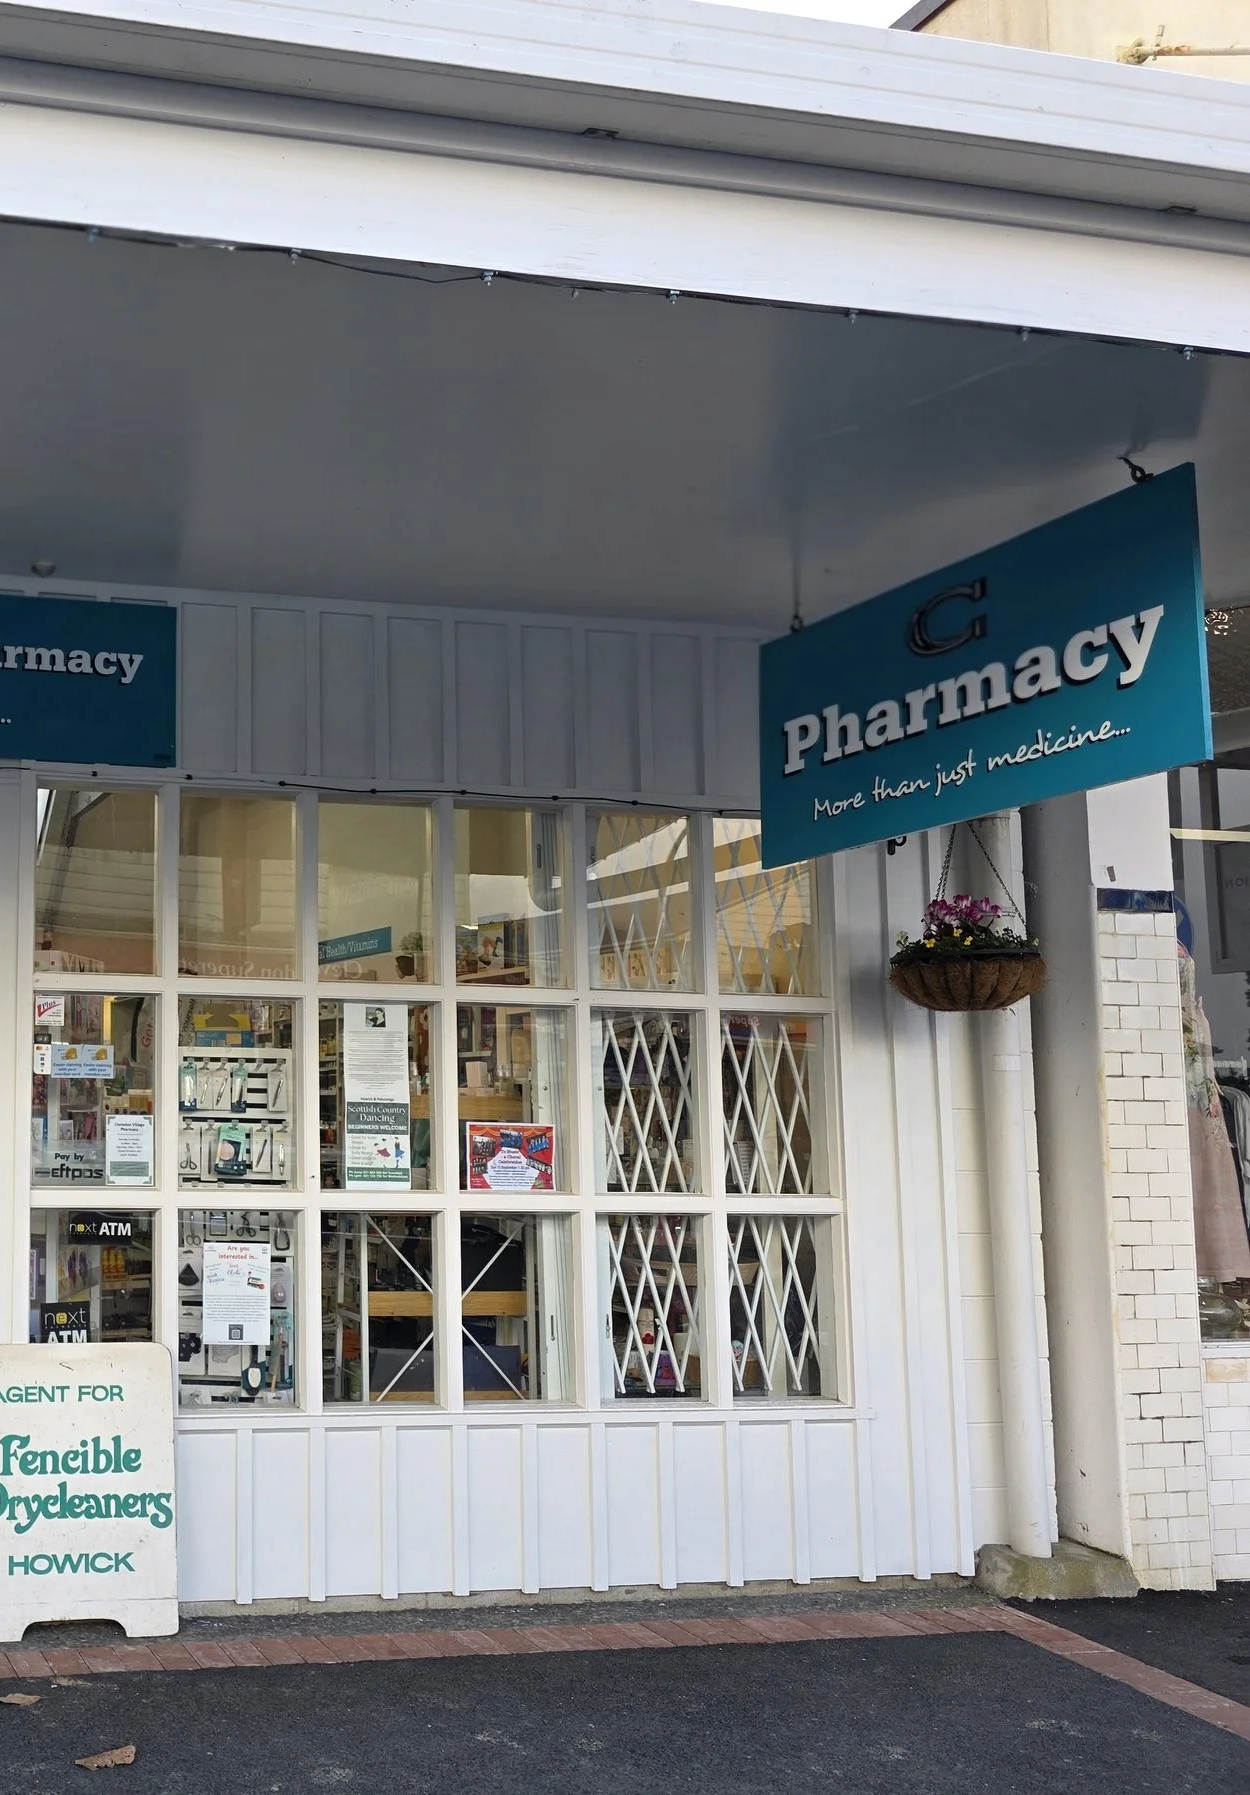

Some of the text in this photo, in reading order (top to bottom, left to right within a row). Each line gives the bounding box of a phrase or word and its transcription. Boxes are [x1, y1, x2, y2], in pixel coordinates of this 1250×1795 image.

[907, 577, 988, 656] C
[782, 604, 1164, 776] Pharmacy
[813, 718, 1132, 821] More than just medicine...
[42, 1000, 57, 1010] Plus
[347, 1105, 406, 1115] Scottish Country
[360, 1113, 396, 1125] Dancing
[54, 1152, 85, 1162] Pay by
[51, 1163, 104, 1181] eftpos
[99, 1222, 132, 1236] ATM
[44, 1307, 87, 1326] next
[46, 1330, 88, 1344] ATM
[77, 1385, 125, 1403] FOR
[7, 1551, 136, 1576] HOWICK
